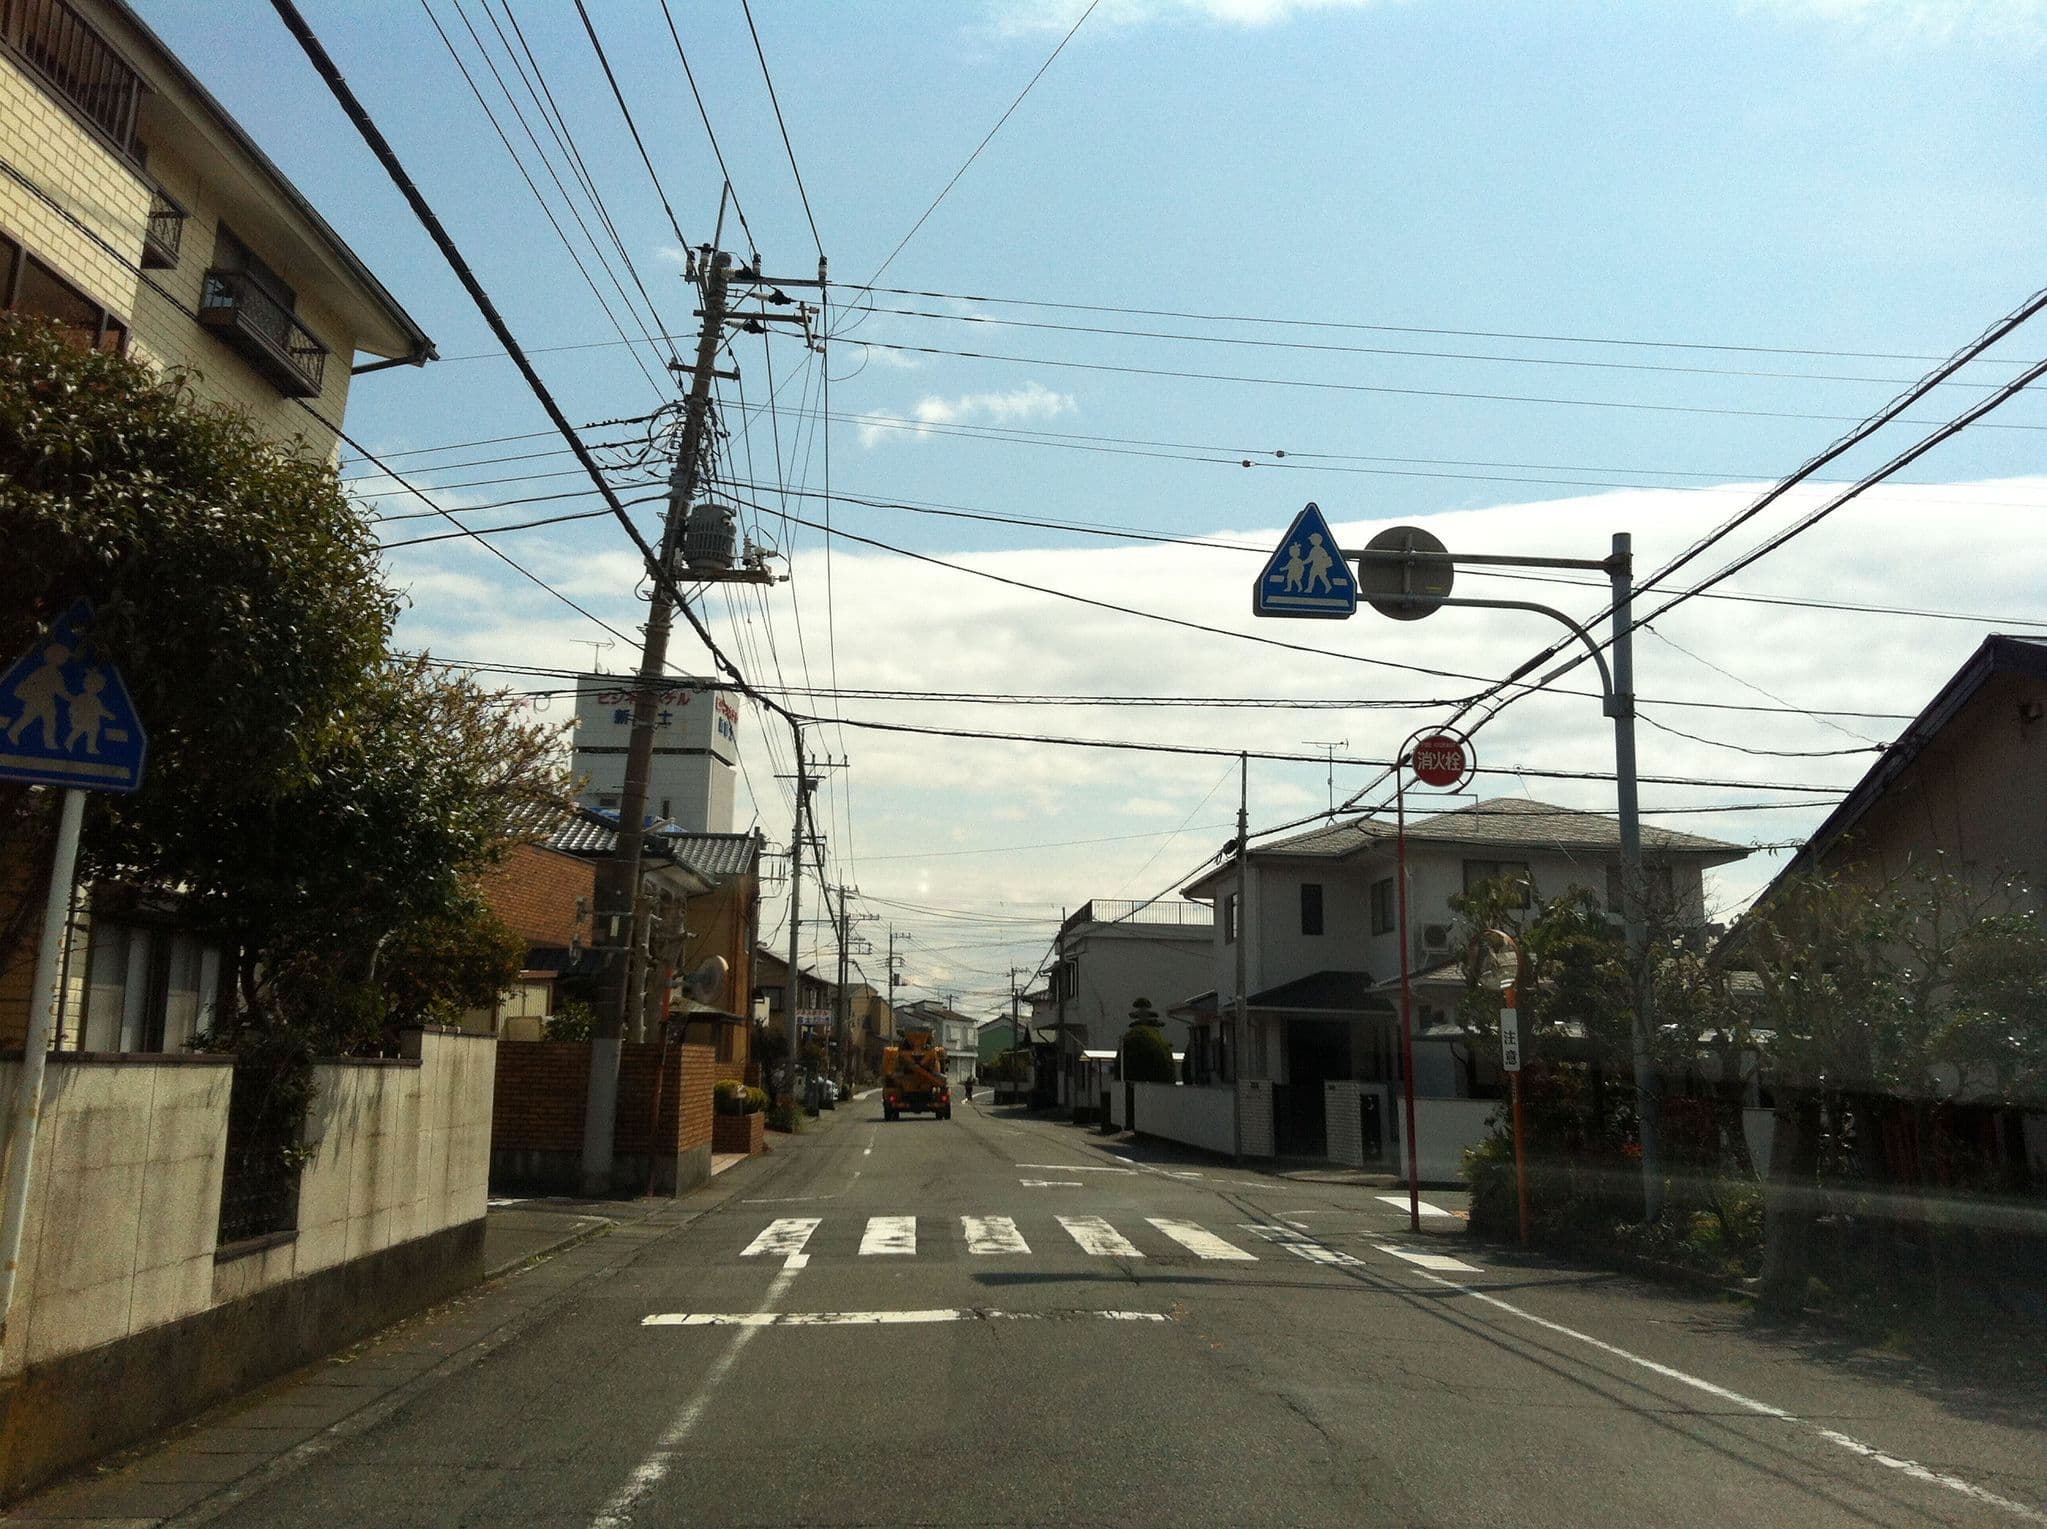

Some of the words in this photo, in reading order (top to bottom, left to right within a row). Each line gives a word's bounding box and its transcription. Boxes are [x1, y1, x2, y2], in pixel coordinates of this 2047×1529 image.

[614, 709, 673, 726] 新士
[1418, 751, 1461, 771] 消火栓
[1503, 1030, 1518, 1065] 注意
